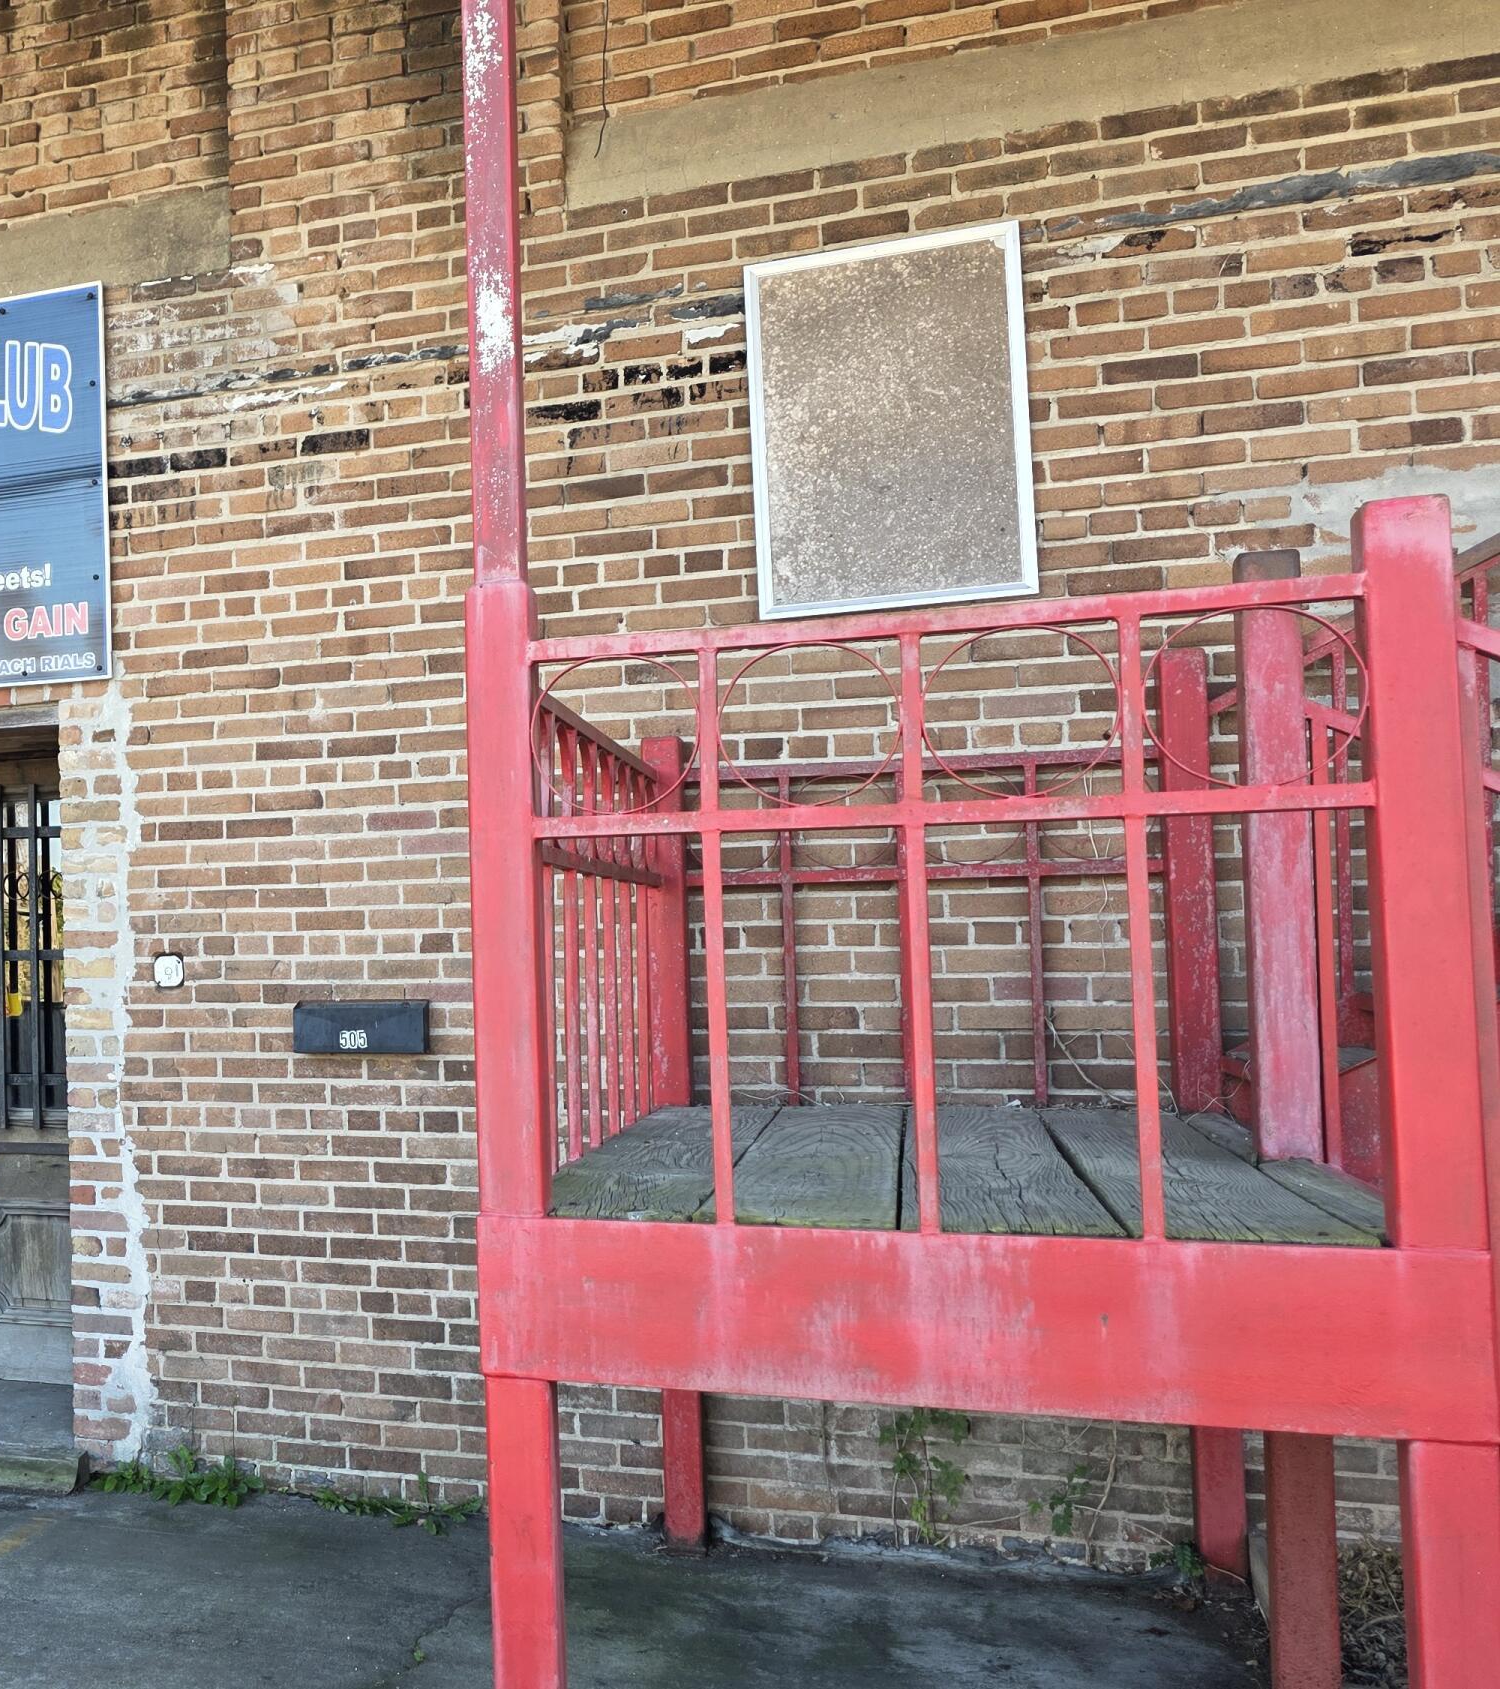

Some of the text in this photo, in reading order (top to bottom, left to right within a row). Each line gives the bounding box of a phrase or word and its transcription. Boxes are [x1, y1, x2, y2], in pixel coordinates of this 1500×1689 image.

[4, 601, 89, 641] GAIN
[41, 652, 97, 672] RIALS
[340, 1030, 367, 1048] 505
